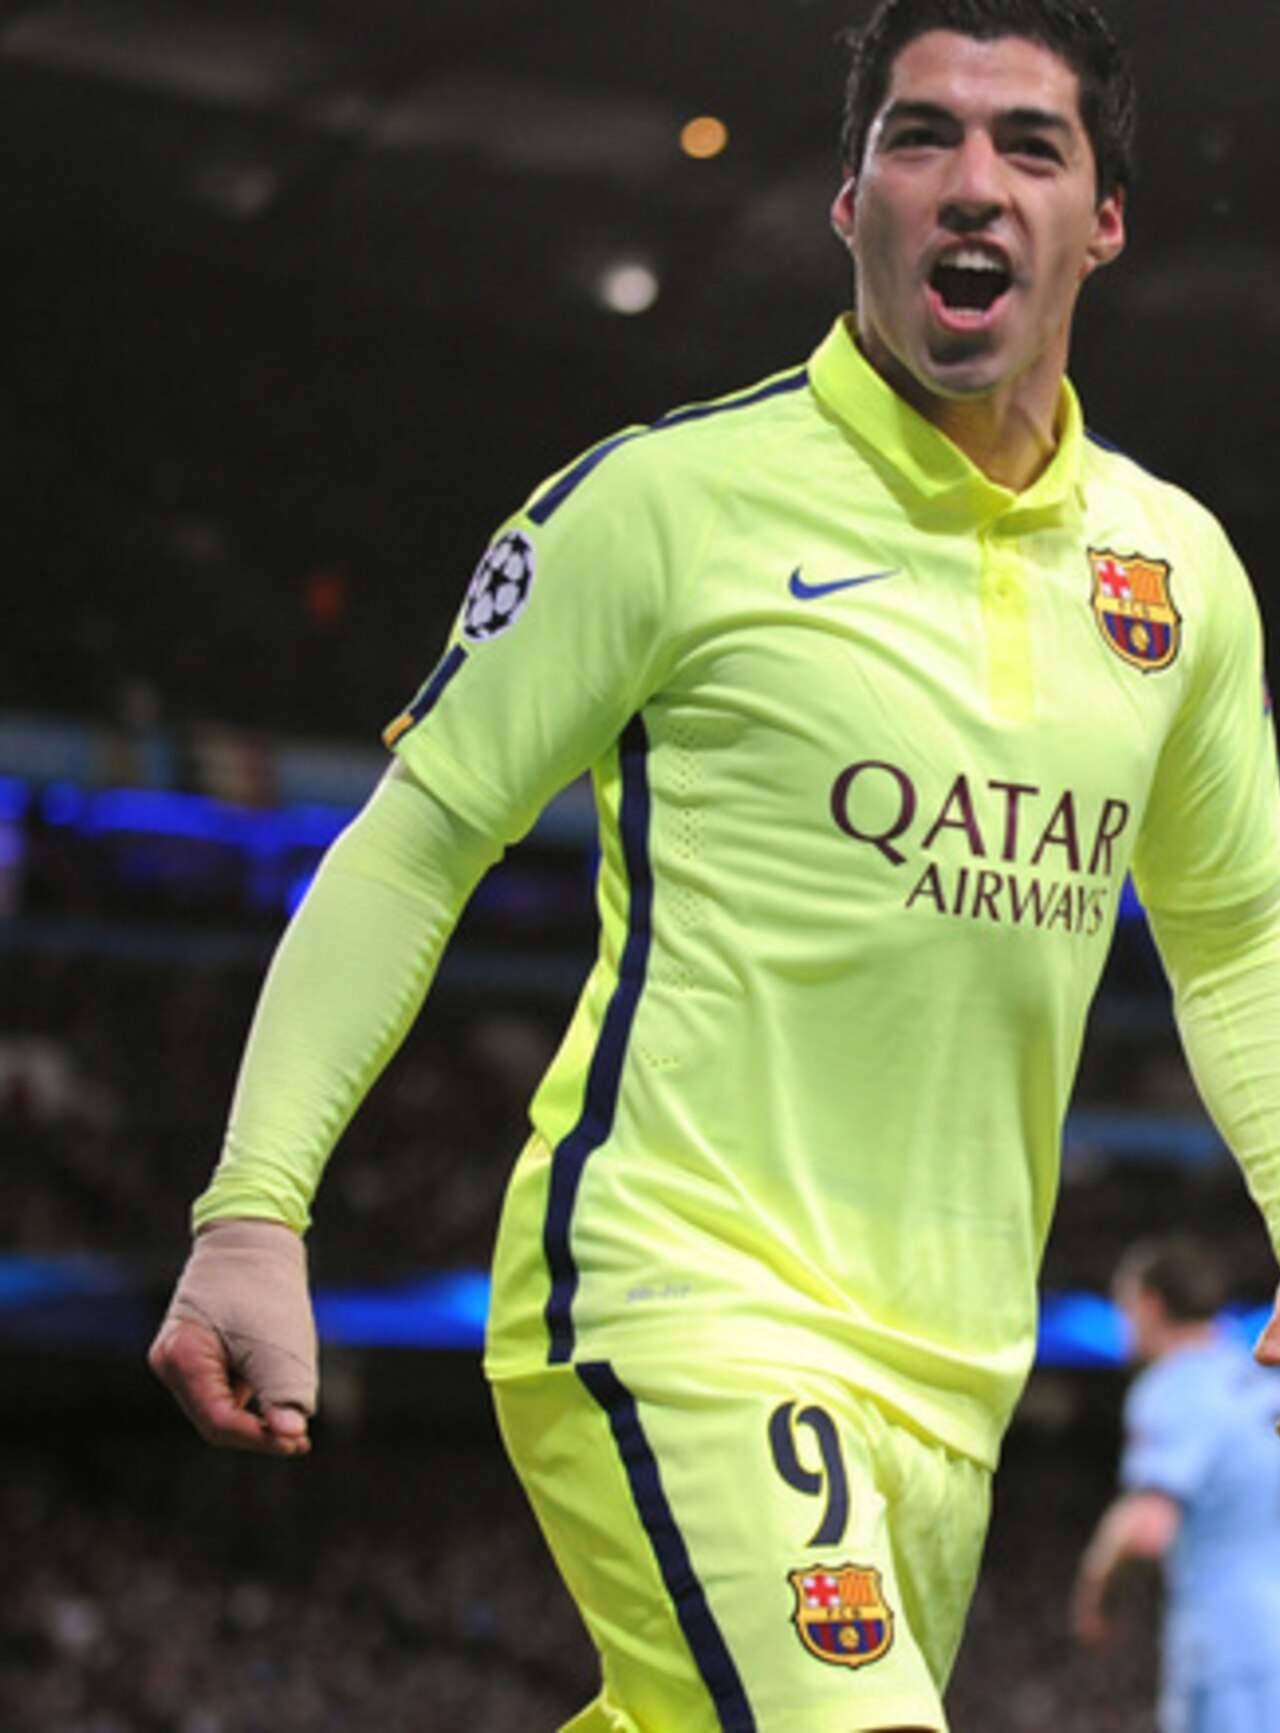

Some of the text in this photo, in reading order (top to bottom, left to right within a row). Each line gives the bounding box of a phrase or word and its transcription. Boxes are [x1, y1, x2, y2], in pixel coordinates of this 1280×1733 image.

[830, 760, 1130, 876] QATAR
[905, 862, 1107, 936] AIRWAYS
[768, 1401, 850, 1548] 9
